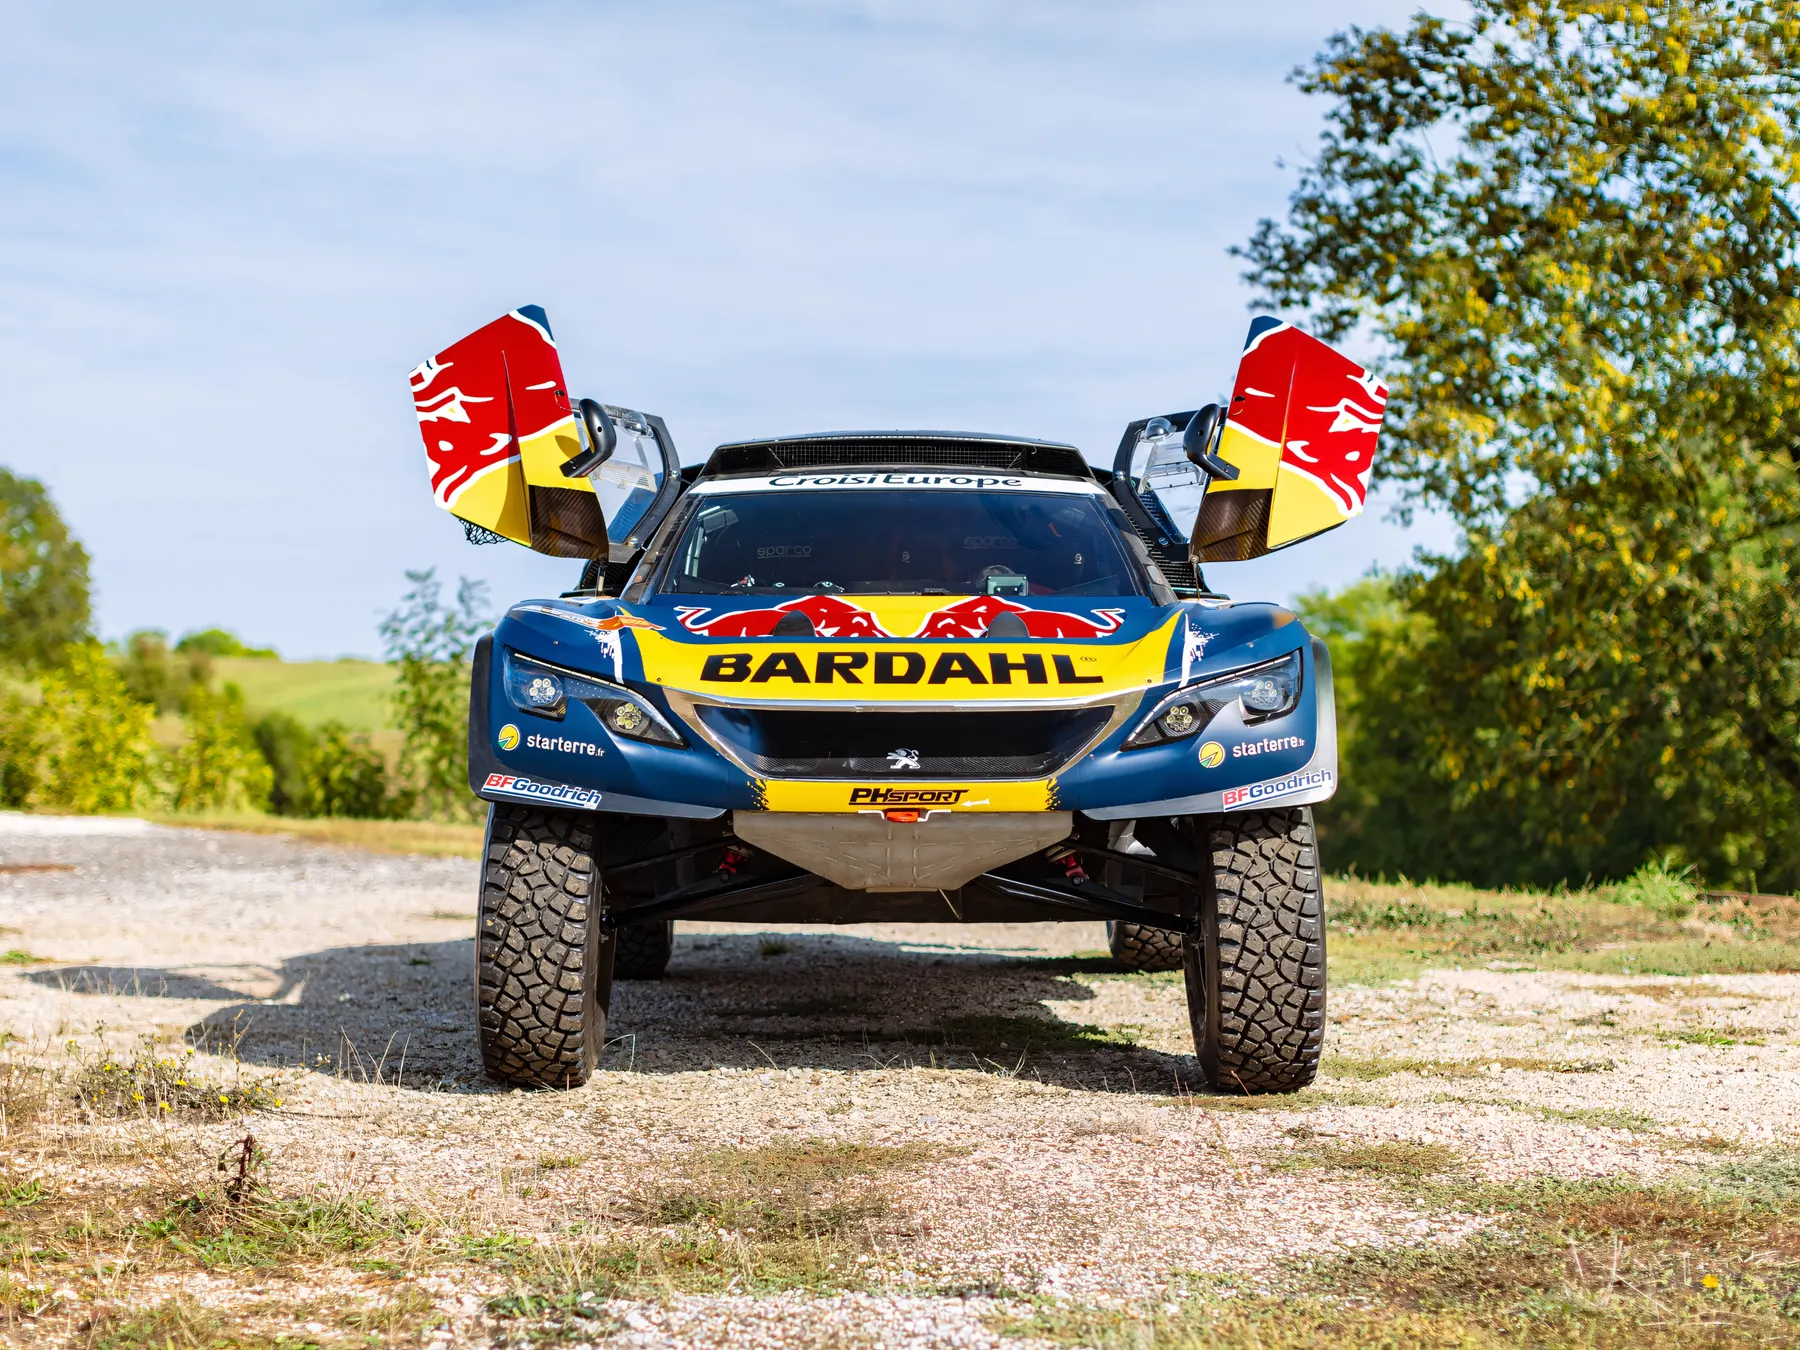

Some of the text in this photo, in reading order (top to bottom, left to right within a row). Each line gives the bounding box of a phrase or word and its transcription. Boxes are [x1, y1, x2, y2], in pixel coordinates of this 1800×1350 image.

[769, 474, 1022, 487] CroisiEurope
[700, 651, 1104, 684] BARDAHL
[484, 773, 601, 804] BFGoodrich
[1223, 769, 1332, 806] BFGoodrich
